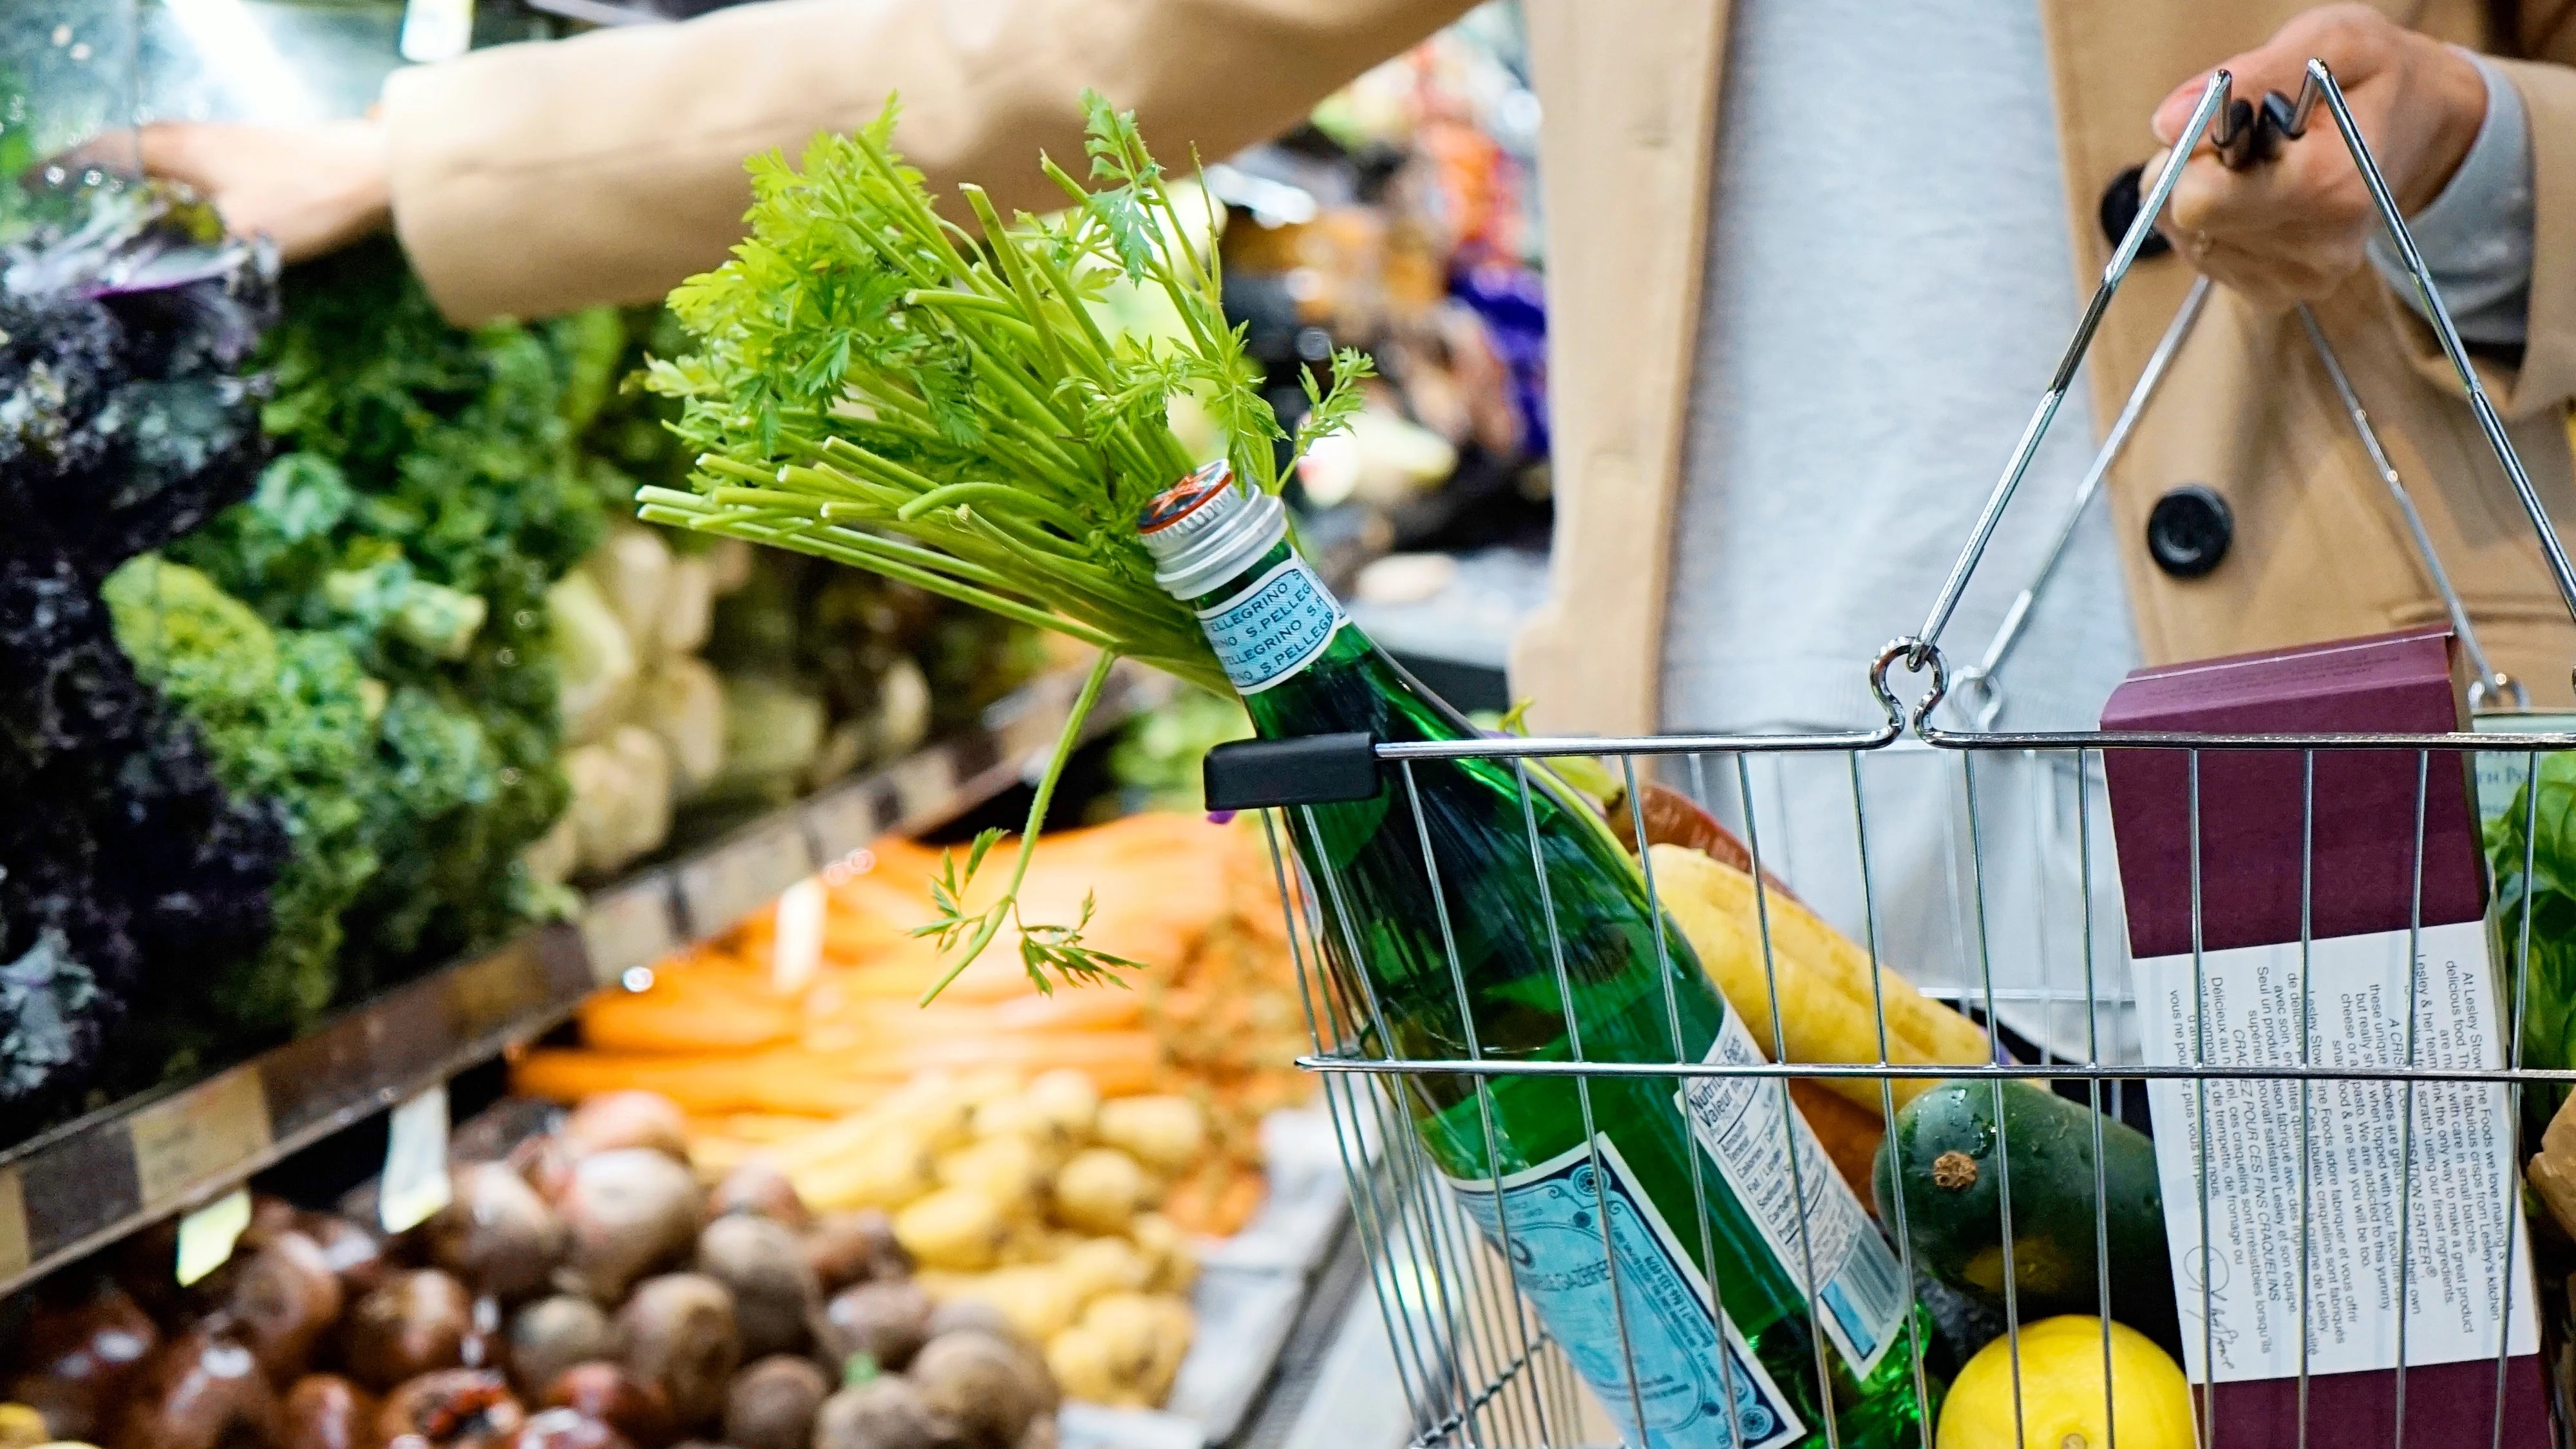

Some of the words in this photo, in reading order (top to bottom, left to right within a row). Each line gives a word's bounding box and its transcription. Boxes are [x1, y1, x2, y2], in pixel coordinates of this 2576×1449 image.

[2257, 966, 2271, 994] Seul
[2417, 954, 2429, 995] Lesley
[2446, 960, 2461, 1016] delicious
[2463, 971, 2474, 985] At
[2170, 989, 2182, 1019] vous
[2211, 976, 2228, 1034] Délicieux
[2262, 998, 2271, 1014] un
[2274, 985, 2286, 1014] avec
[2356, 992, 2367, 1012] but
[2421, 999, 2432, 1008] &
[2465, 989, 2477, 1030] Lesley
[2174, 1023, 2184, 1038] ne
[2341, 993, 2354, 1039] cheese
[2423, 1012, 2434, 1032] her
[2200, 1001, 2219, 1087] accompags
[2220, 1037, 2230, 1053] au
[2248, 1009, 2265, 1067] supérieu
[2263, 1017, 2279, 1060] produit
[2280, 1018, 2289, 1047] soin,
[2359, 1016, 2372, 1050] really
[2440, 1028, 2450, 1050] are
[2454, 1019, 2467, 1050] food.
[2233, 1028, 2253, 1097] CRAEZ
[2283, 1051, 2293, 1066] en
[2311, 1035, 2325, 1066] Stow
[2333, 1039, 2344, 1068] snac
[2348, 1042, 2356, 1056] or
[2426, 1037, 2438, 1069] team
[2175, 1041, 2190, 1090] pouz
[2223, 1056, 2237, 1103] nurel,
[2364, 1052, 2376, 1086] she
[2415, 1058, 2427, 1086] frm
[2443, 1053, 2456, 1088] me
[2458, 1052, 2472, 1092] The
[2213, 1090, 2223, 1106] de
[2257, 1079, 2271, 1124] pouvait
[2271, 1064, 2282, 1109] aison
[2287, 1077, 2298, 1112] etites
[2351, 1059, 2365, 1118] apasto.
[2432, 1079, 2445, 1103] ink
[2183, 1092, 2195, 1119] plus
[2229, 1106, 2240, 1128] ces
[2342, 1110, 2352, 1119] &
[2369, 1089, 2380, 1123] when
[2389, 1017, 2400, 1027] A
[2398, 1087, 2423, 1198] CORSATION
[2419, 1090, 2434, 1135] scratch
[2436, 1106, 2446, 1126] the
[2448, 1092, 2461, 1117] with
[2243, 1100, 2259, 1141] POUR
[2288, 972, 2298, 989] de
[2309, 1135, 2324, 1187] fabuleux
[2318, 1190, 2333, 1253] craquelins
[2326, 1256, 2338, 1283] sont
[2320, 1108, 2334, 1146] Foods
[2344, 1124, 2353, 1144] are
[2358, 1121, 2368, 1142] We
[2452, 1121, 2463, 1149] care
[2464, 1095, 2477, 1148] fabulous
[2480, 1108, 2494, 1148] Foods
[2188, 1122, 2200, 1151] vous
[2216, 1110, 2231, 1172] trempette,
[2278, 1113, 2293, 1162] fabriqué
[2369, 983, 2380, 1018] these
[2376, 1022, 2387, 1065] unique
[2382, 1079, 2394, 1121] ackers
[2388, 1124, 2397, 1144] are
[2410, 1289, 2420, 1314] own
[2373, 1126, 2389, 1169] topped
[2438, 1130, 2450, 1156] only
[2233, 1131, 2249, 1195] craquelins
[2249, 1144, 2264, 1174] CES
[2264, 1127, 2279, 1182] satisfaire
[2326, 1150, 2338, 1186] adore
[2347, 1148, 2358, 1175] sure
[2362, 1145, 2371, 1166] are
[2425, 1138, 2436, 1172] using
[2457, 1152, 2466, 1164] in
[2471, 1151, 2482, 1188] crisps
[2486, 1151, 2496, 1169] we
[2224, 1175, 2235, 1191] de
[2285, 1166, 2297, 1195] avec
[2380, 1171, 2392, 1197] with
[2430, 1175, 2440, 1195] our
[2443, 1159, 2452, 1184] way
[2458, 1167, 2472, 1200] small
[2488, 1172, 2499, 1198] love
[2253, 1177, 2268, 1208] FINS
[2349, 1179, 2361, 1200] you
[2365, 1169, 2381, 1222] addicted
[2447, 1186, 2455, 1199] to
[2242, 1198, 2253, 1224] sont
[2272, 1186, 2285, 1226] Lesley
[2289, 1198, 2299, 1221] des
[2331, 1189, 2346, 1244] fabriquer
[2355, 1204, 2366, 1224] will
[2380, 1201, 2394, 1227] your
[2433, 1198, 2447, 1232] finest
[2448, 1202, 2459, 1236] make
[2476, 1191, 2486, 1219] from
[2225, 1195, 2241, 1246] fromage
[2278, 1229, 2289, 1241] et
[2358, 1227, 2367, 1243] be
[2372, 1226, 2382, 1238] to
[2463, 1204, 2476, 1256] batches.
[2491, 1202, 2505, 1248] making
[2234, 1249, 2244, 1265] ou
[2246, 1227, 2262, 1296] irrésistibles
[2258, 1211, 2281, 1302] CRAQUELINS
[2280, 1245, 2291, 1267] son
[2307, 1227, 2319, 1270] cuisine
[2339, 1247, 2349, 1259] et
[2360, 1246, 2370, 1267] too.
[2374, 1241, 2386, 1262] this
[2481, 1224, 2496, 1273] Lesley's
[2313, 1273, 2324, 1290] de
[2341, 1262, 2353, 1291] vous
[2451, 1251, 2467, 1283] great
[2374, 1266, 2391, 1311] yummy
[2487, 1276, 2501, 1321] kitchen
[2345, 1294, 2358, 1323] offrir
[2456, 1286, 2474, 1333] product
